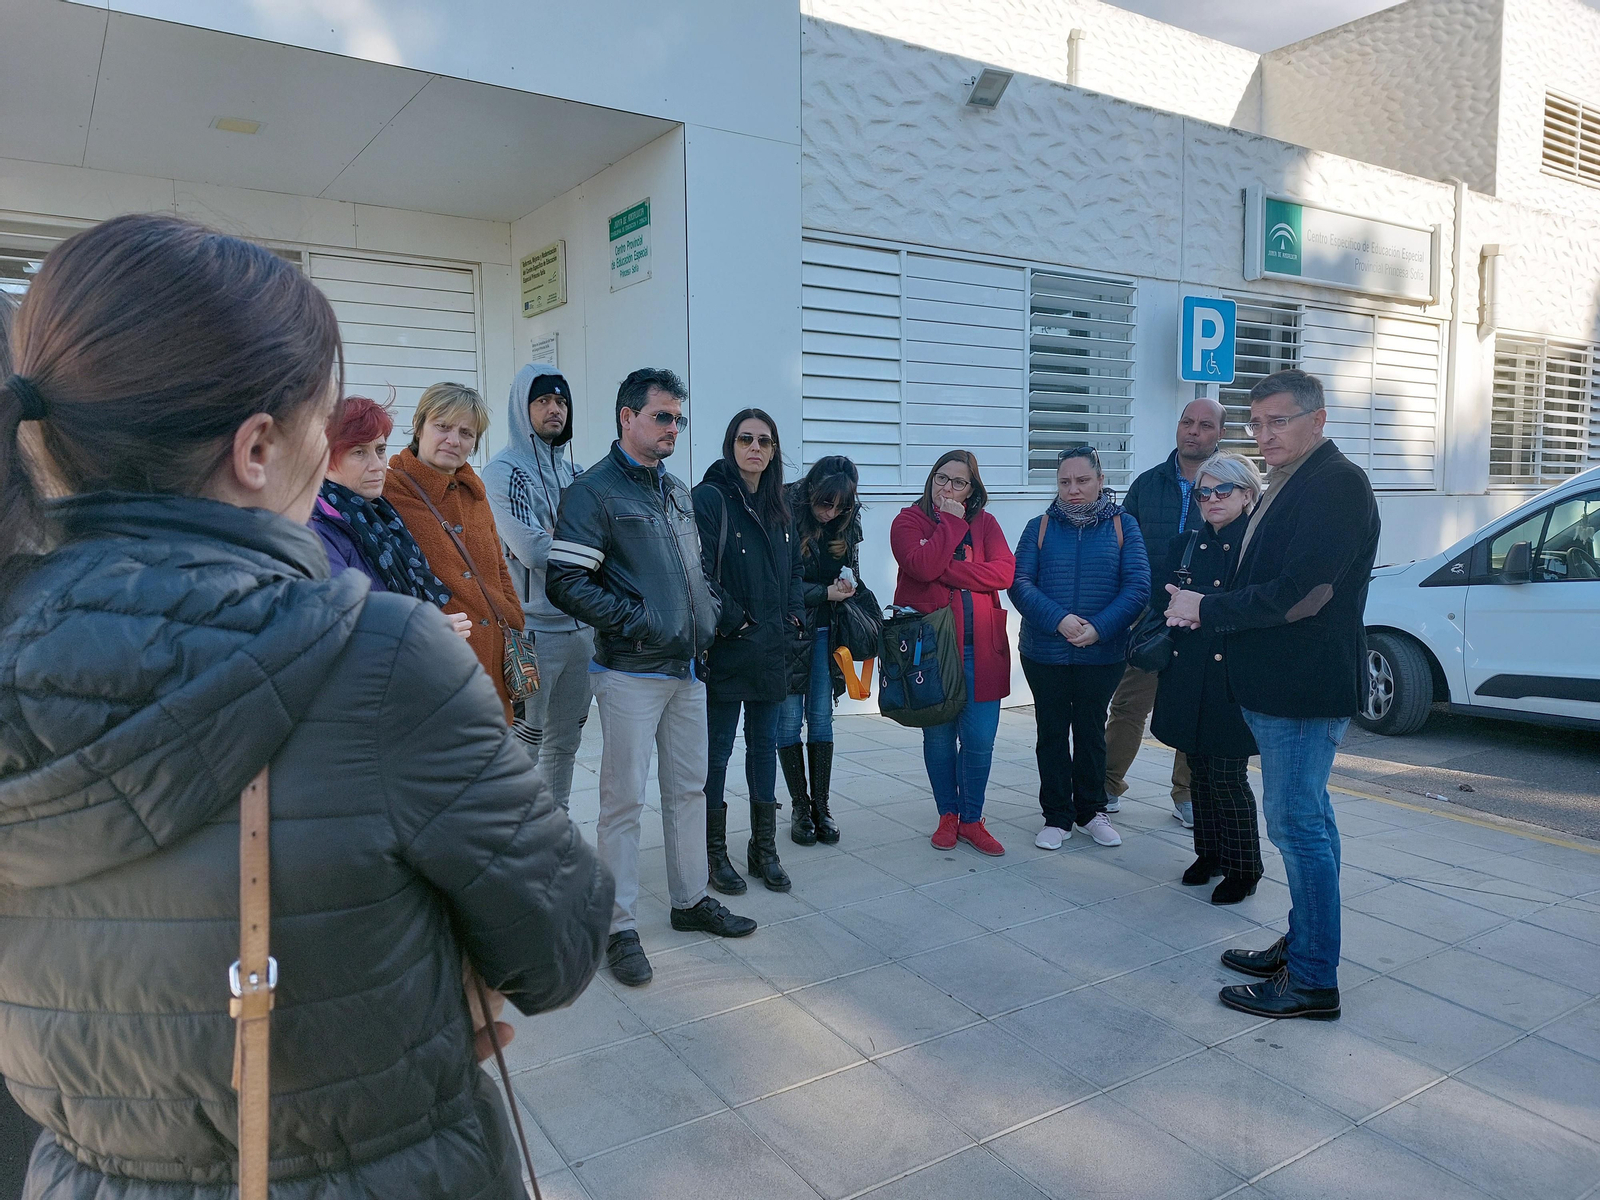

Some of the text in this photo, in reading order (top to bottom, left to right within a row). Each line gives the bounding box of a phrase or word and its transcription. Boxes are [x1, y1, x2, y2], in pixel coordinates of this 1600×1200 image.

[611, 245, 648, 270] de Educación Especial
[615, 234, 643, 256] Centro Provincial
[1307, 229, 1425, 264] Centro Específico de Educación Especial
[1354, 258, 1424, 281] Provincial Princesa Sofía
[1192, 306, 1225, 372] P
